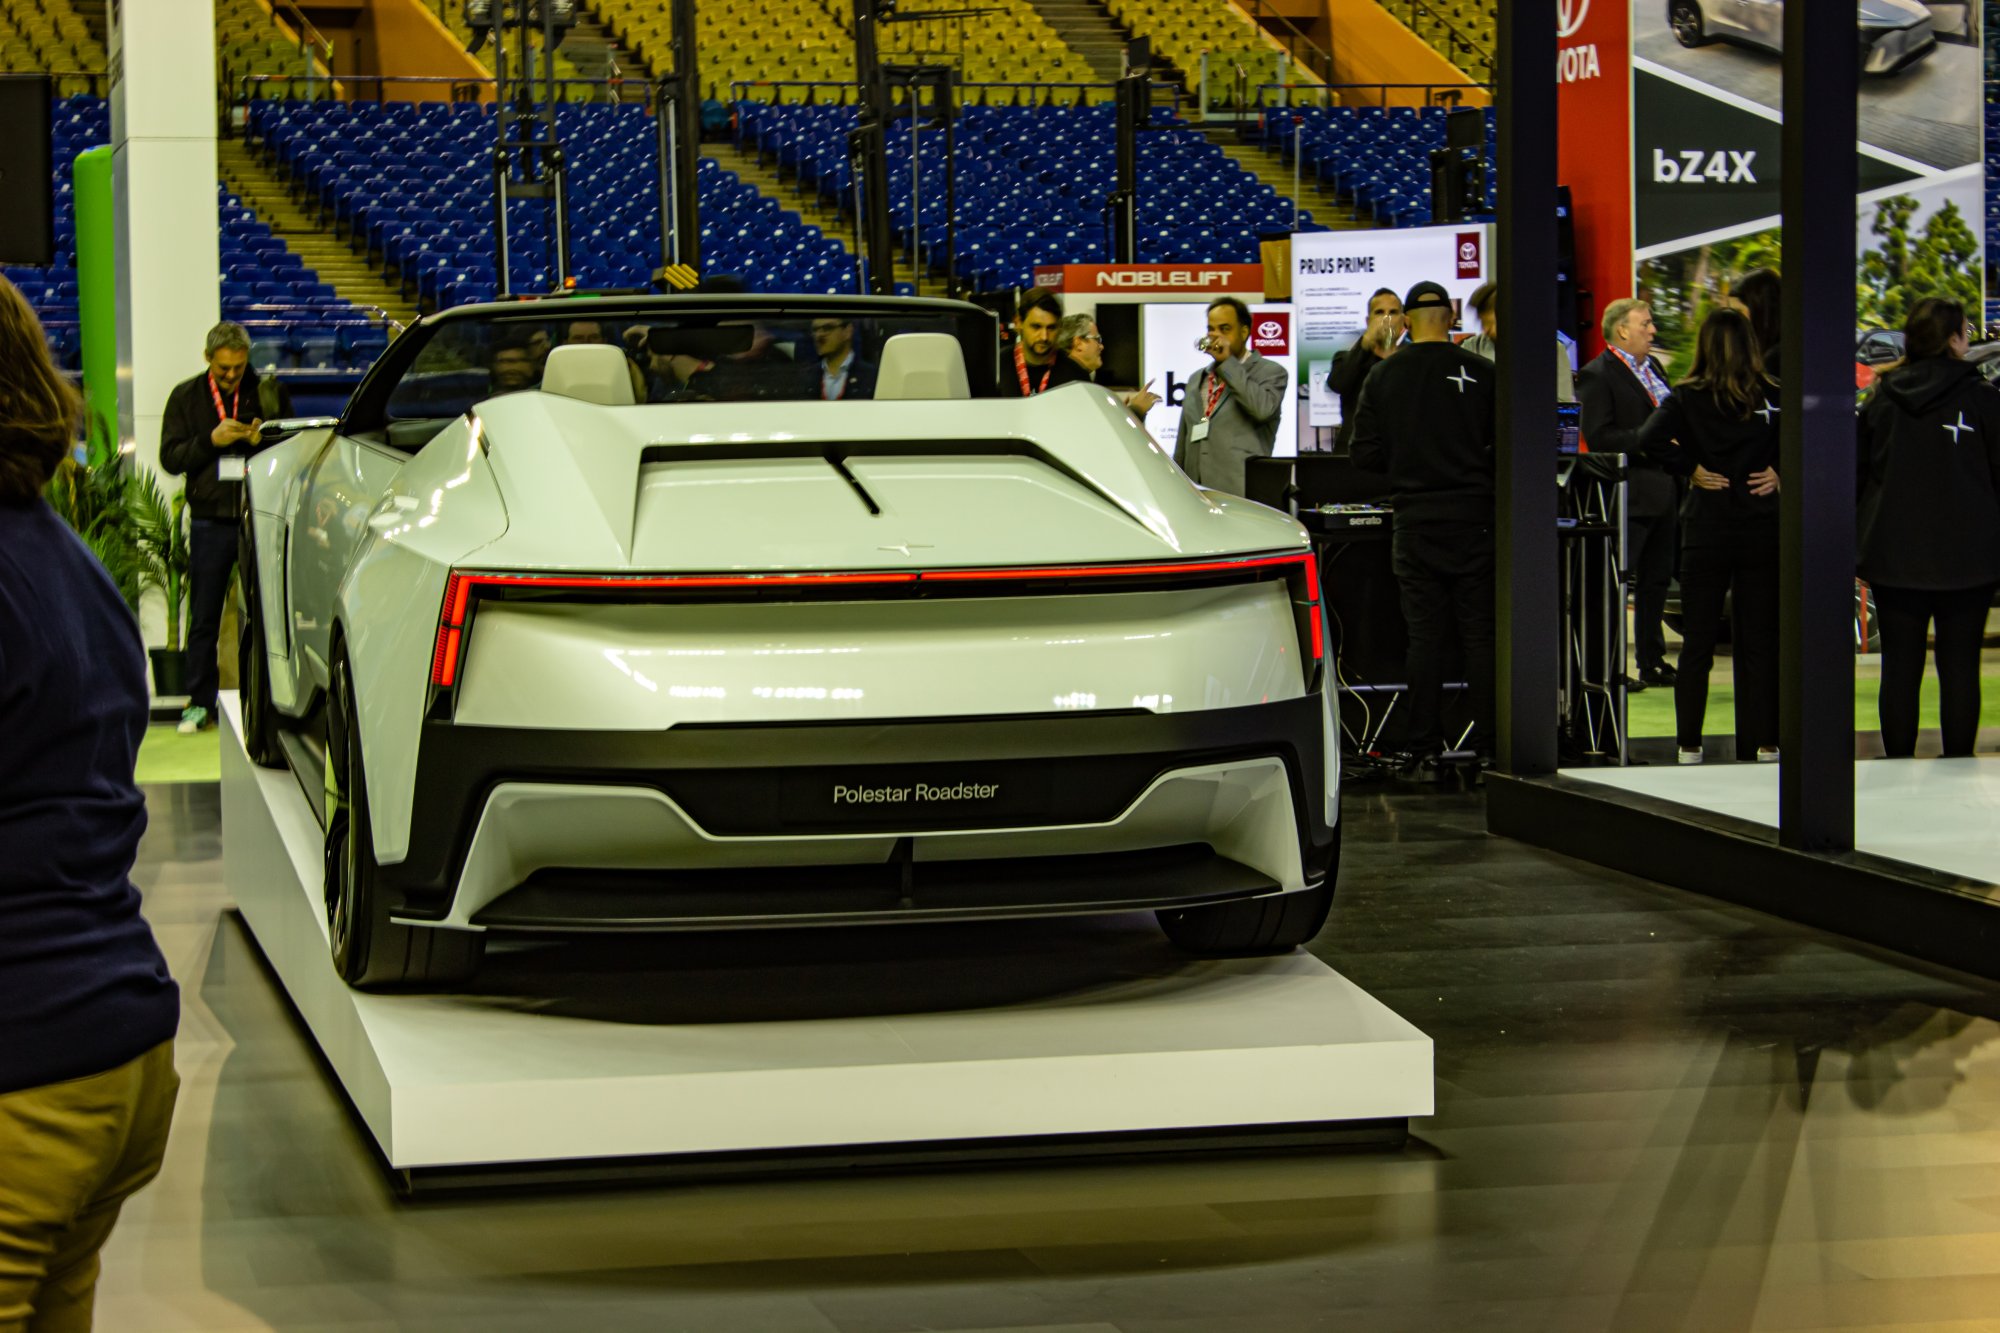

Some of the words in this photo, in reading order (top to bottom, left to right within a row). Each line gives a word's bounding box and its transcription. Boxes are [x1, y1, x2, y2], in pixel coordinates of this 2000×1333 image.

[1556, 44, 1600, 83] YOTA
[1653, 148, 1757, 183] bZ4X
[1300, 258, 1334, 275] PRIUS
[1337, 256, 1375, 273] PRIME
[1096, 271, 1232, 286] NOBLELIFT
[1254, 338, 1286, 347] TOYOTA
[1349, 516, 1382, 526] serato
[834, 785, 911, 804] Polestar
[915, 782, 999, 801] Roadster
